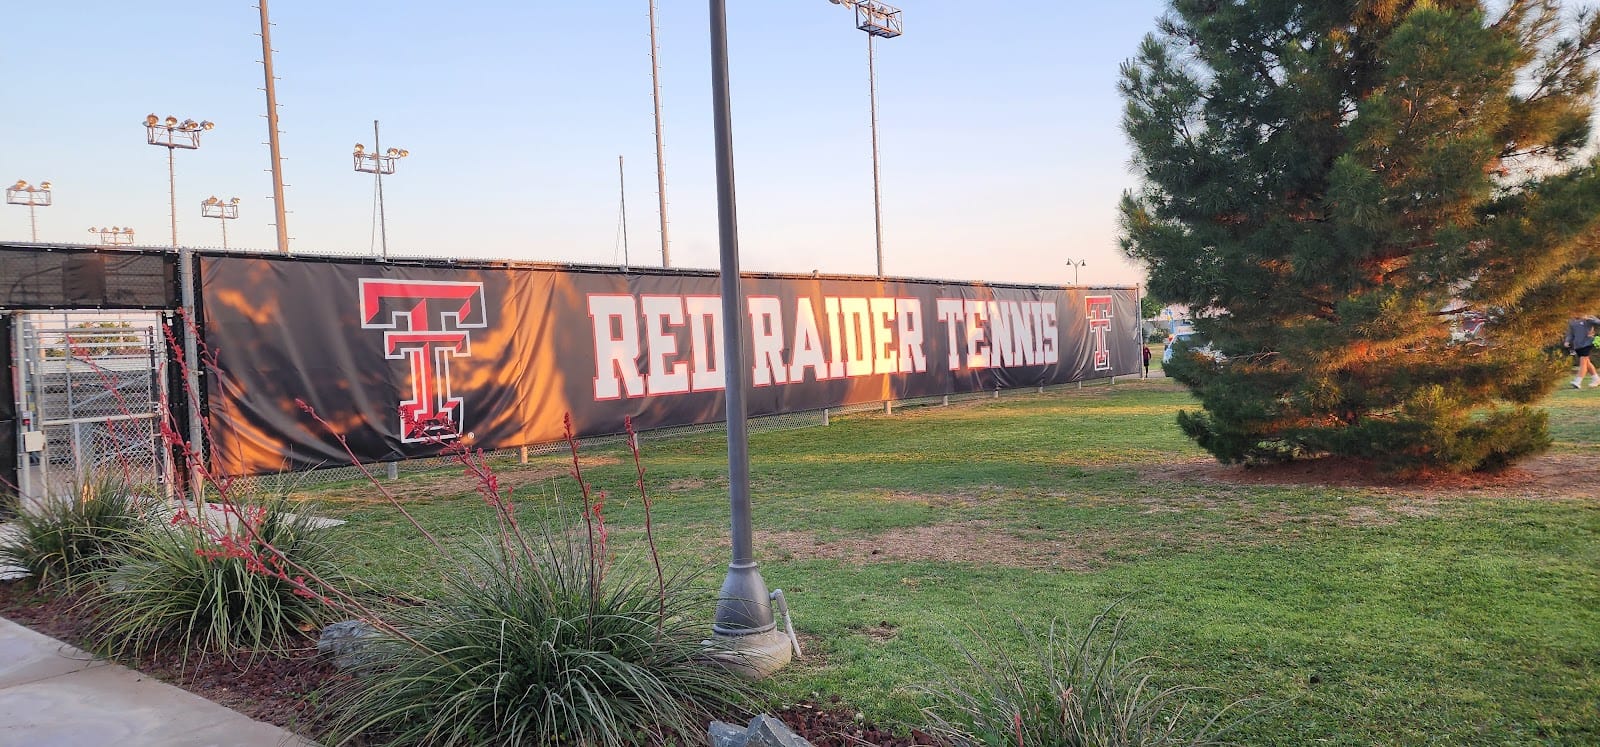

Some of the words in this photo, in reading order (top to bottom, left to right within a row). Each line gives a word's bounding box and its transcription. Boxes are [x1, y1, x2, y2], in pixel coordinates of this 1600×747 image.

[586, 293, 727, 401] RED
[747, 295, 927, 387] RAIDER
[936, 298, 1059, 371] TENNIS
